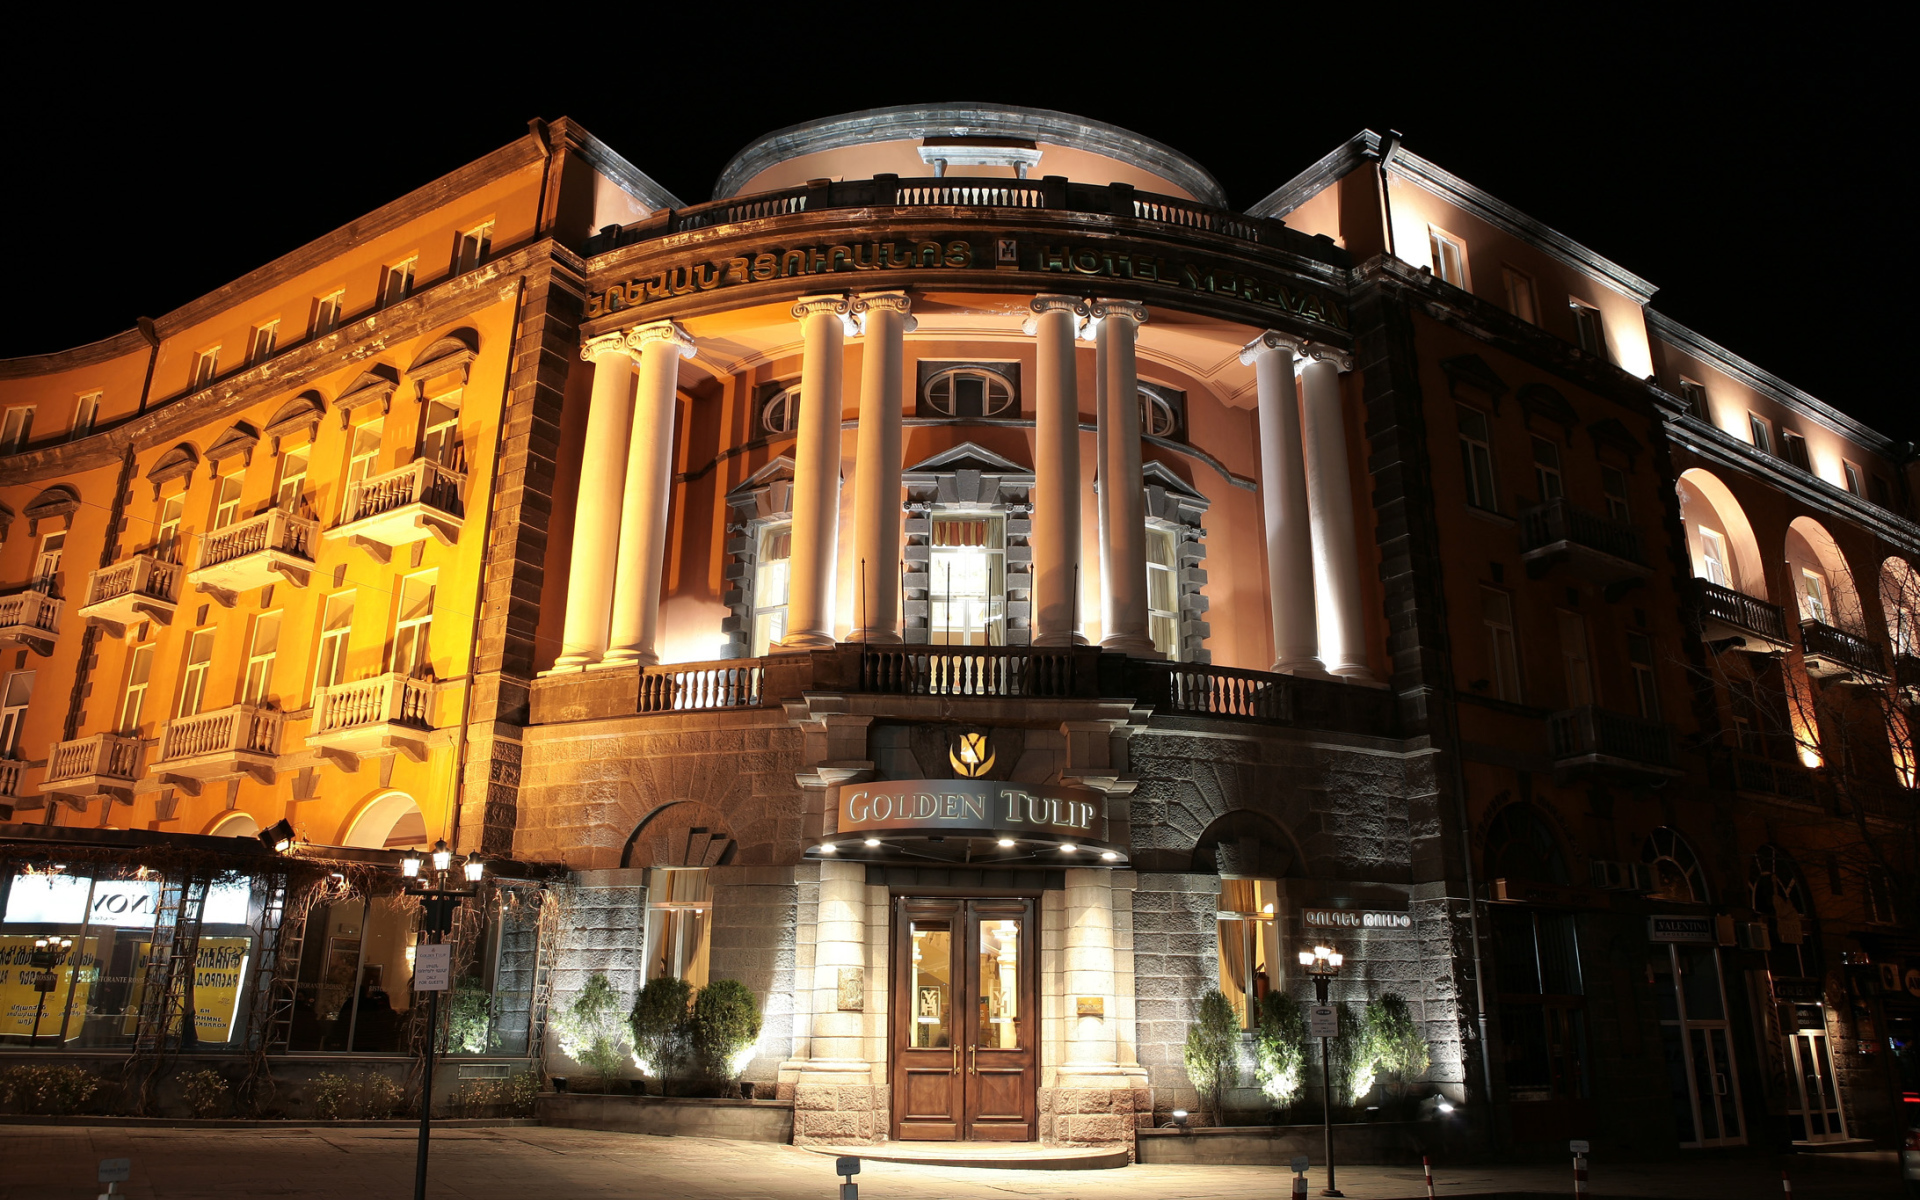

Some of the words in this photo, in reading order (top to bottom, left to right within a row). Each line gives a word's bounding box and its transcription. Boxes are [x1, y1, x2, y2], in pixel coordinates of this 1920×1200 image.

[585, 261, 720, 319] ԵՐԵՎԱՆ
[727, 240, 972, 283] ՀՅՈՒՐԱՆՈՑ
[1041, 246, 1181, 286] HOTEL
[1184, 262, 1349, 331] YEREVAN
[845, 791, 986, 823] GOLDEN
[1000, 789, 1097, 830] TULIP
[1306, 911, 1361, 927] ԳՈԼԴԵՆ
[1363, 912, 1411, 928] ԹՈՒԼԻՓ
[1657, 921, 1708, 932] VALENTINA
